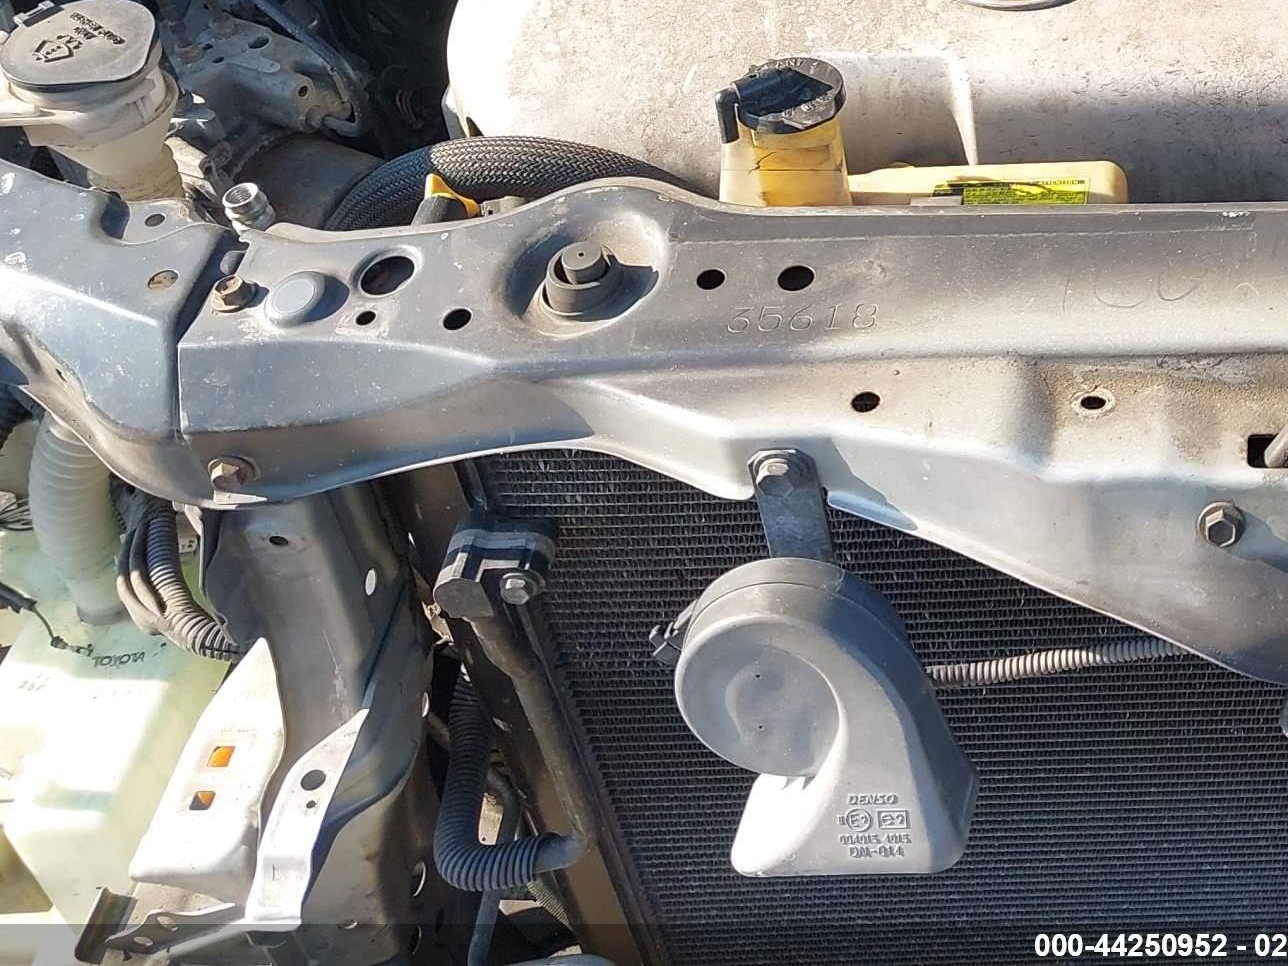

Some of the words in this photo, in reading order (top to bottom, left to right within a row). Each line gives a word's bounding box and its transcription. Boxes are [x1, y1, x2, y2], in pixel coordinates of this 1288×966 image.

[726, 302, 879, 334] 35618
[92, 651, 146, 668] TOYOTA
[847, 793, 899, 806] DENSO
